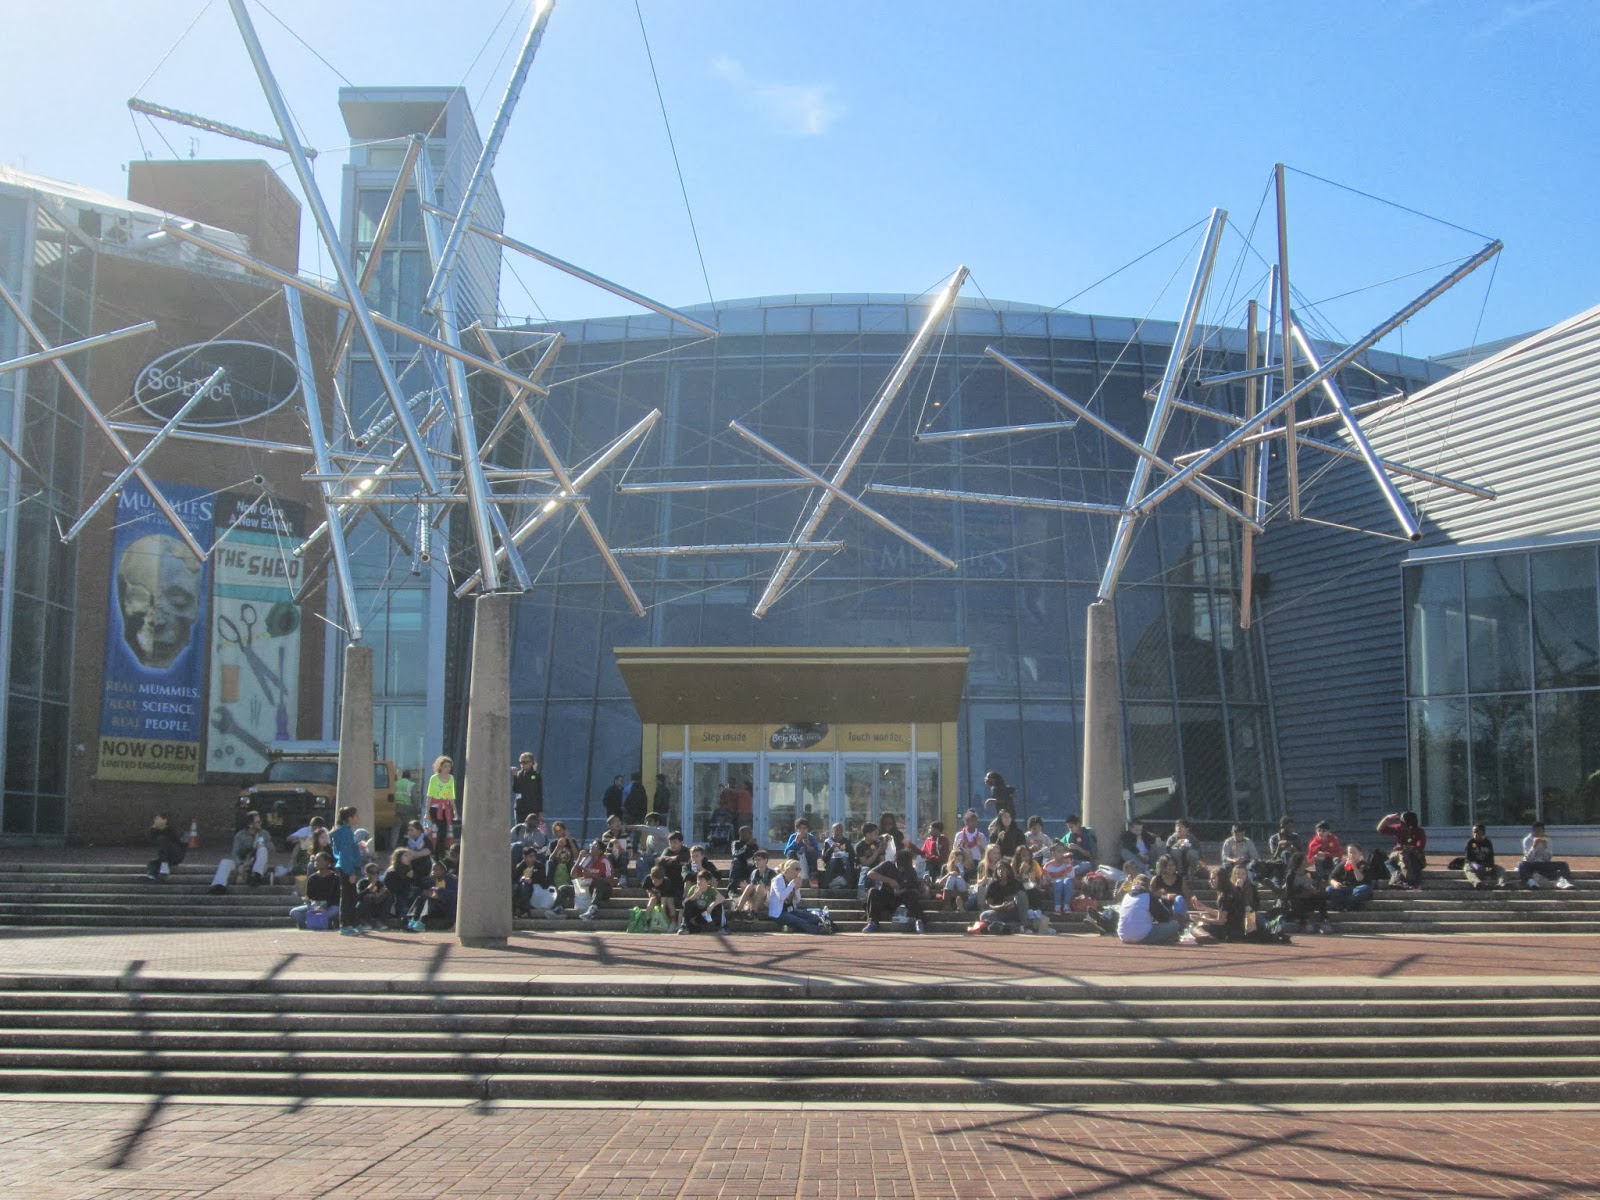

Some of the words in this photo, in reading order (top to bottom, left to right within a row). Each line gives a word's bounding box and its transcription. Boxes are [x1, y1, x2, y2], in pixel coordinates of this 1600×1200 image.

[236, 500, 257, 513] Now
[260, 504, 285, 518] Open
[229, 513, 236, 524] A
[238, 514, 259, 527] New
[217, 547, 247, 569] THE
[246, 555, 300, 580] SHED
[138, 683, 200, 698] MUMMIES.
[142, 700, 195, 715] SCIENCE.
[145, 718, 191, 732] PEOPLE.
[703, 731, 720, 743] Step
[722, 731, 746, 742] inside
[848, 731, 870, 742] Touch
[102, 740, 146, 758] NOW
[150, 743, 197, 761] OPEN
[101, 759, 136, 769] LIMITED
[137, 761, 195, 773] ENGAGEMENT
